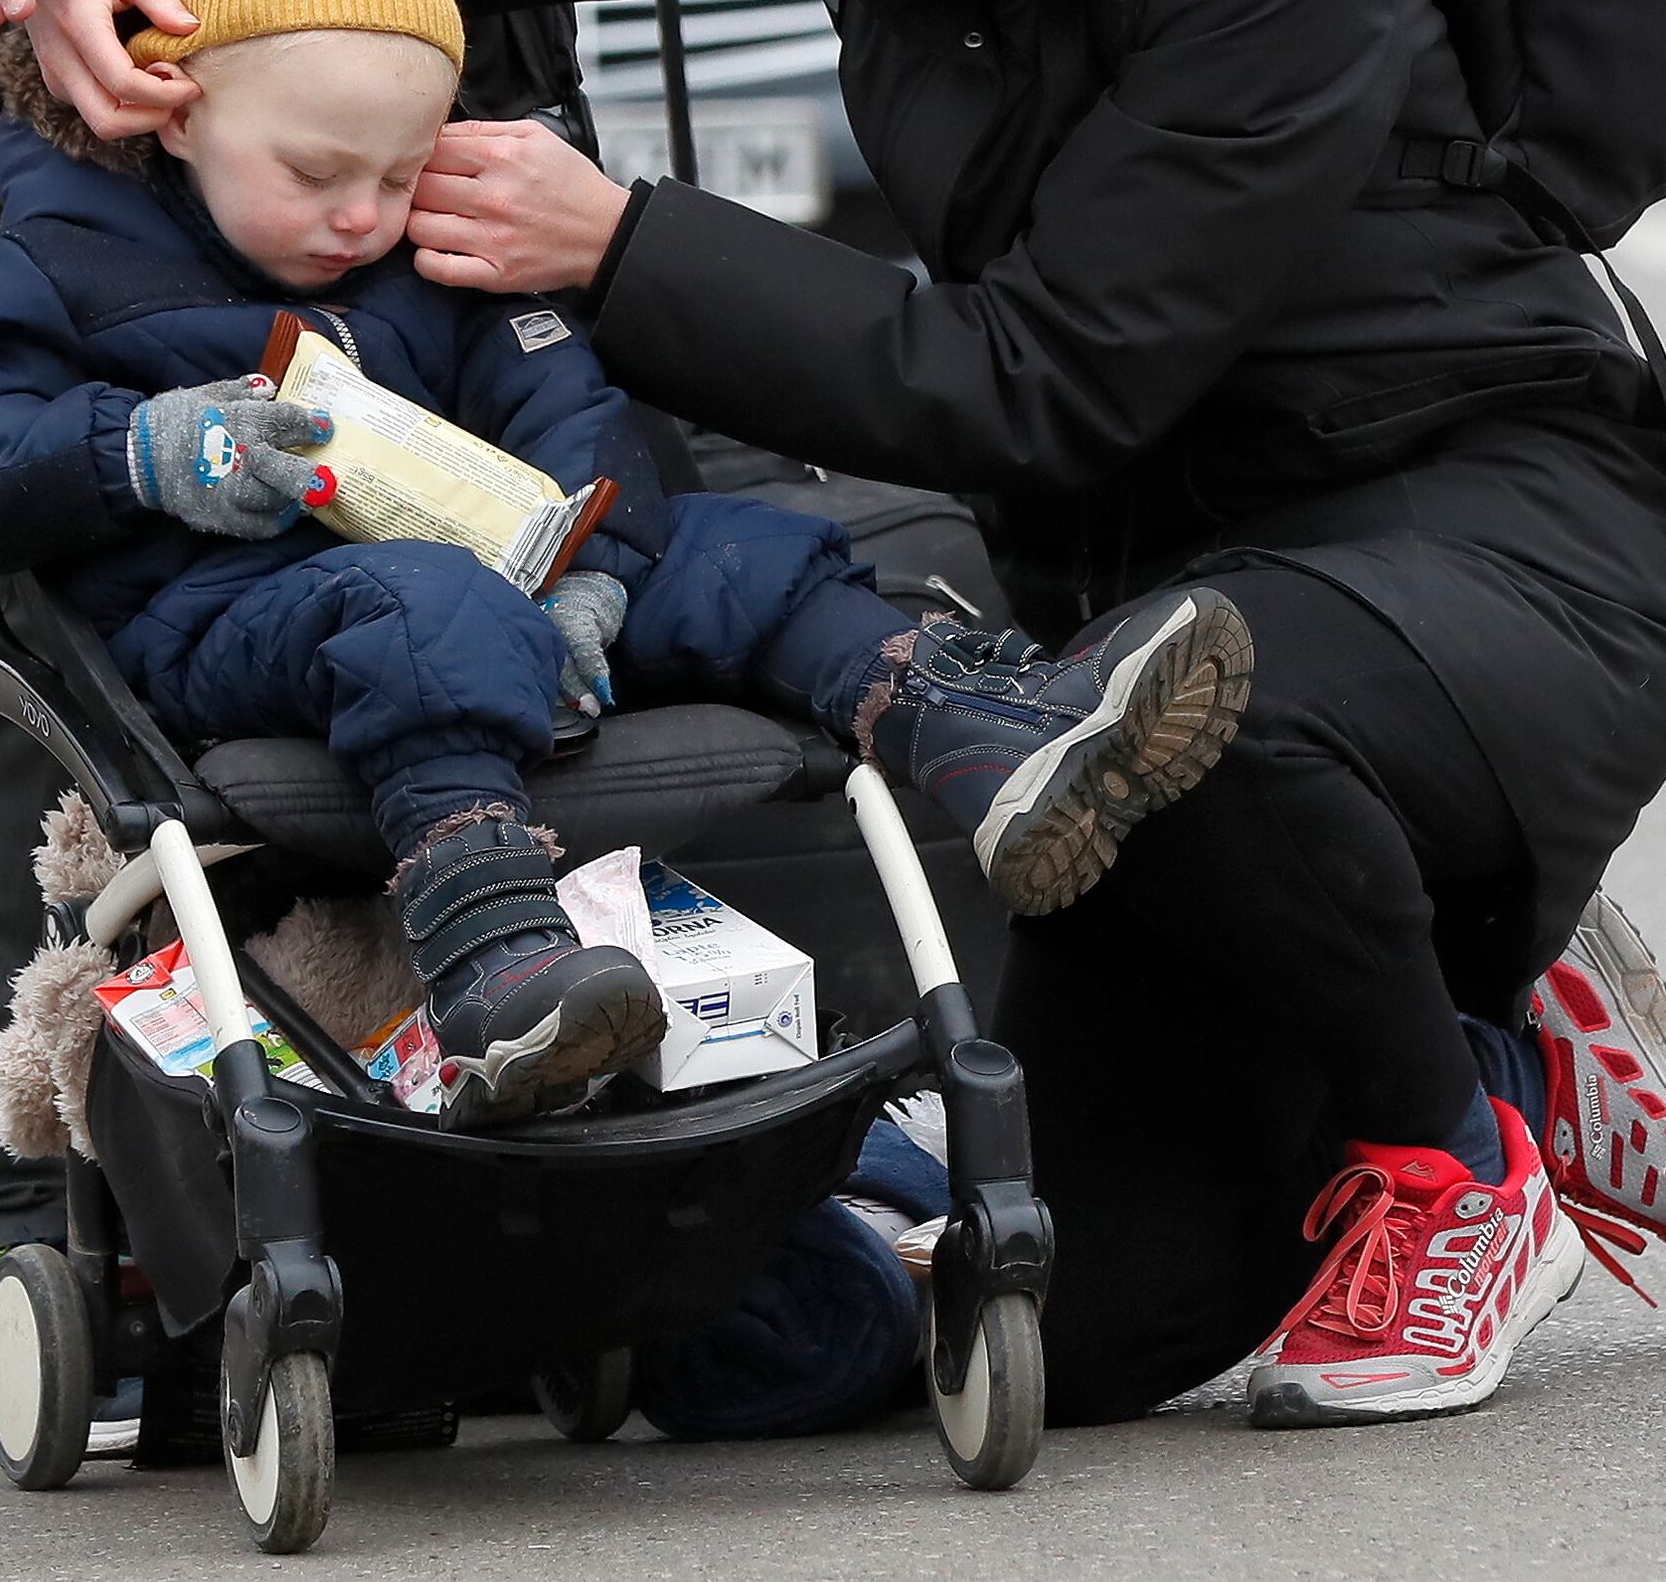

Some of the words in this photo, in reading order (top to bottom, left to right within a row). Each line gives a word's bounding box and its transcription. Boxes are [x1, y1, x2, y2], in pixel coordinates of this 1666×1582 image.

[652, 917, 724, 937] ORNA
[1585, 1074, 1604, 1145] Columbia
[1447, 1207, 1505, 1298] Columbia
